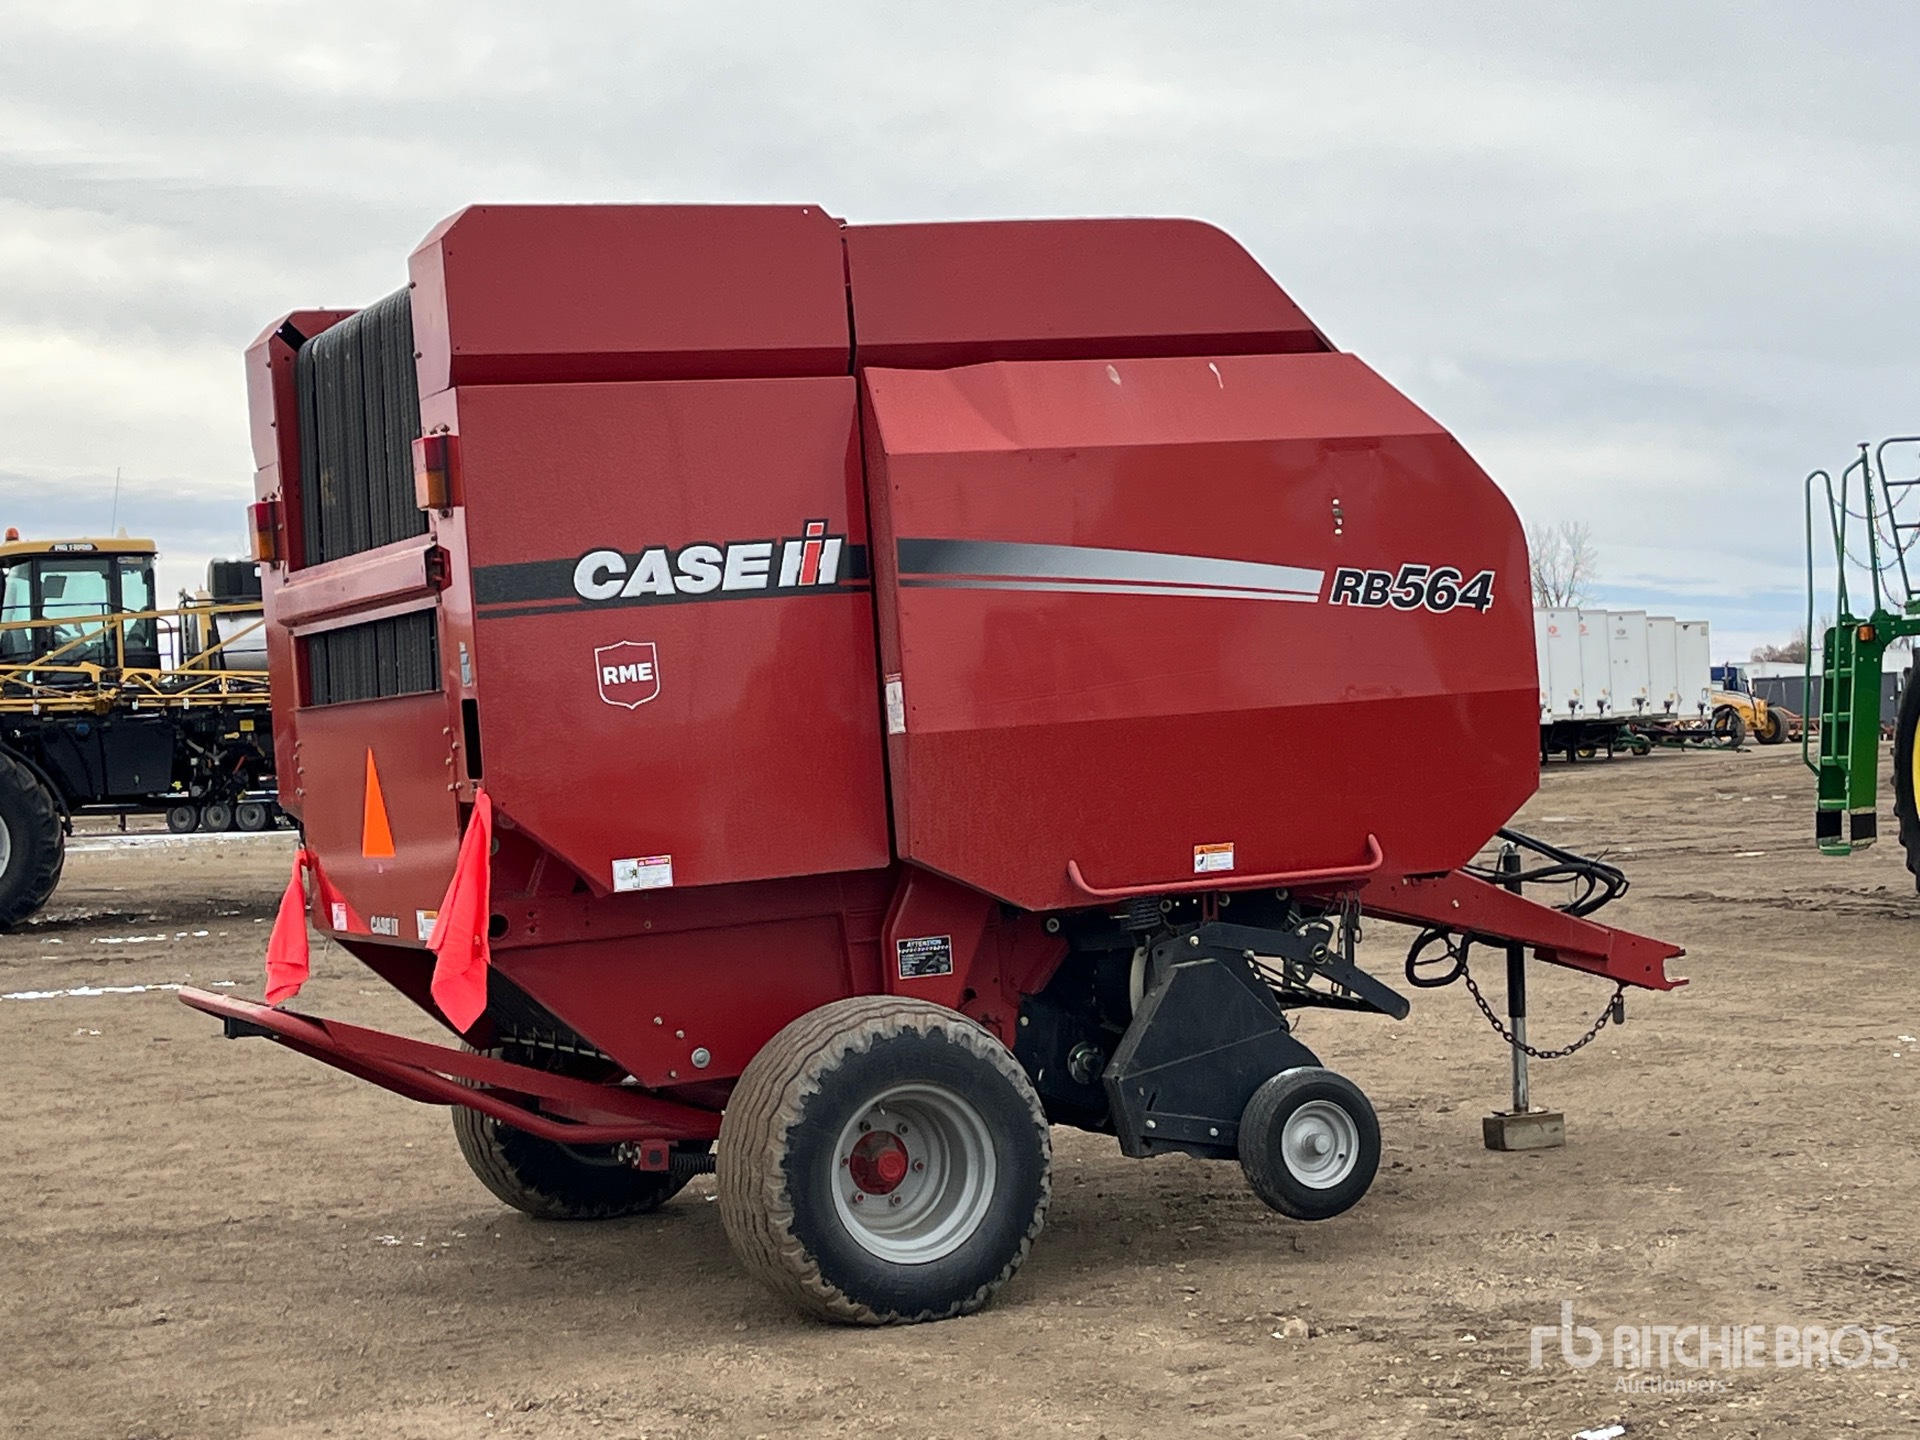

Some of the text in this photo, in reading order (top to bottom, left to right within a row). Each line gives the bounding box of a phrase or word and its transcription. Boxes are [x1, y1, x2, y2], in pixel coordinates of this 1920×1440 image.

[573, 543, 773, 601] CASE
[1329, 563, 1496, 614] RB564
[603, 662, 653, 685] RME
